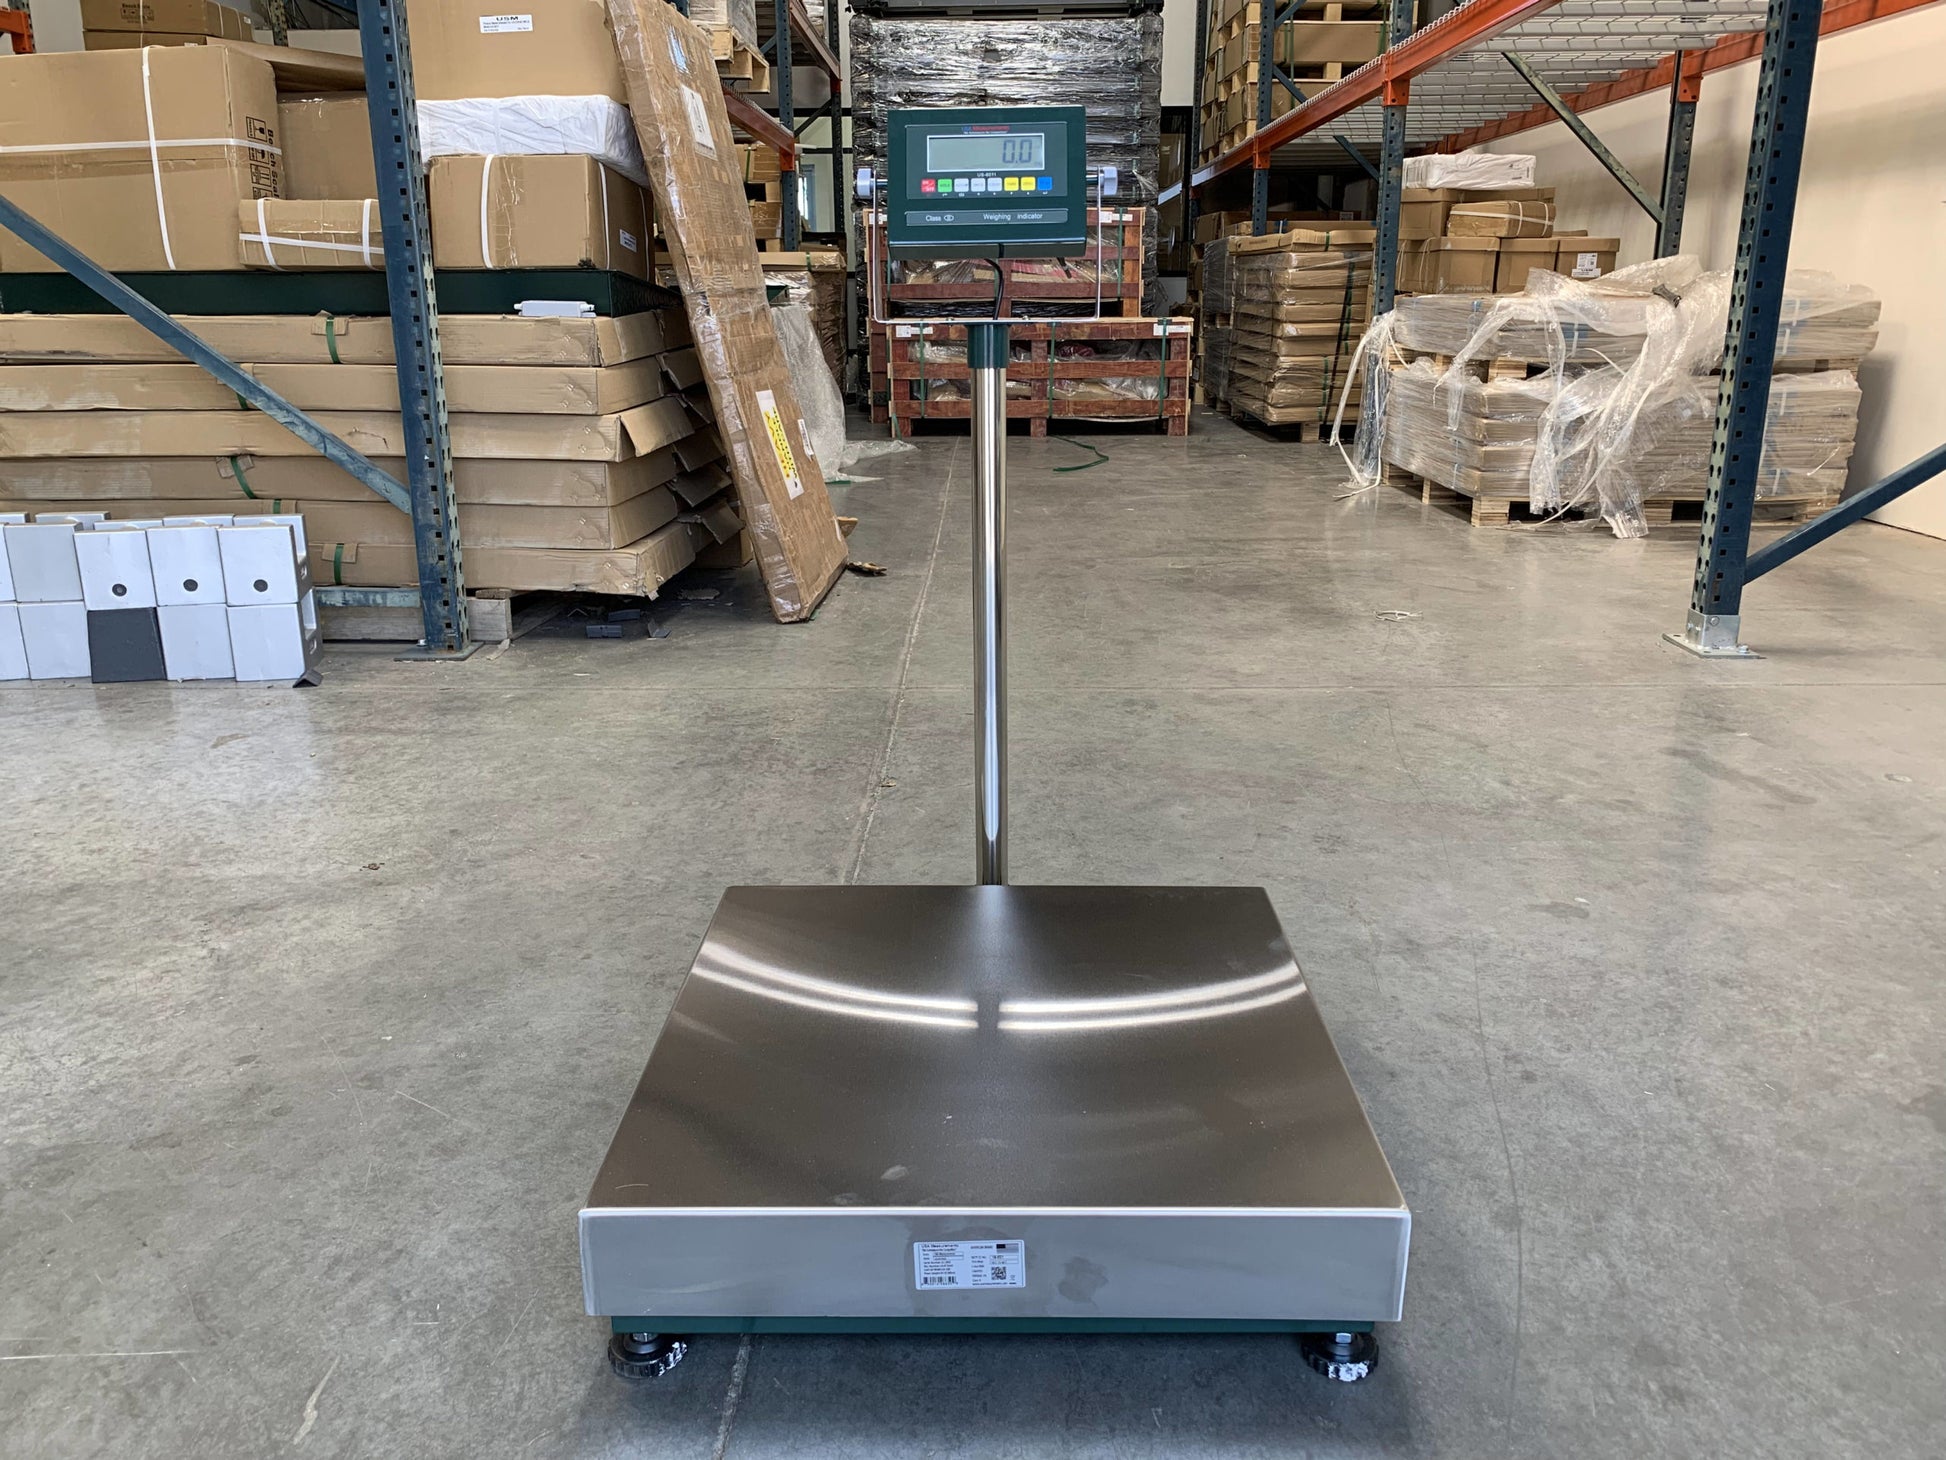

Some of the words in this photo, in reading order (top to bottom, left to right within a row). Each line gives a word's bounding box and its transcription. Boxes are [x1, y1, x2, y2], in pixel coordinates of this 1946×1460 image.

[267, 129, 277, 167] Bech
[1002, 139, 1032, 163] 0.0
[271, 170, 280, 198] Scal
[925, 214, 941, 222] Class
[983, 212, 1011, 221] Weighing
